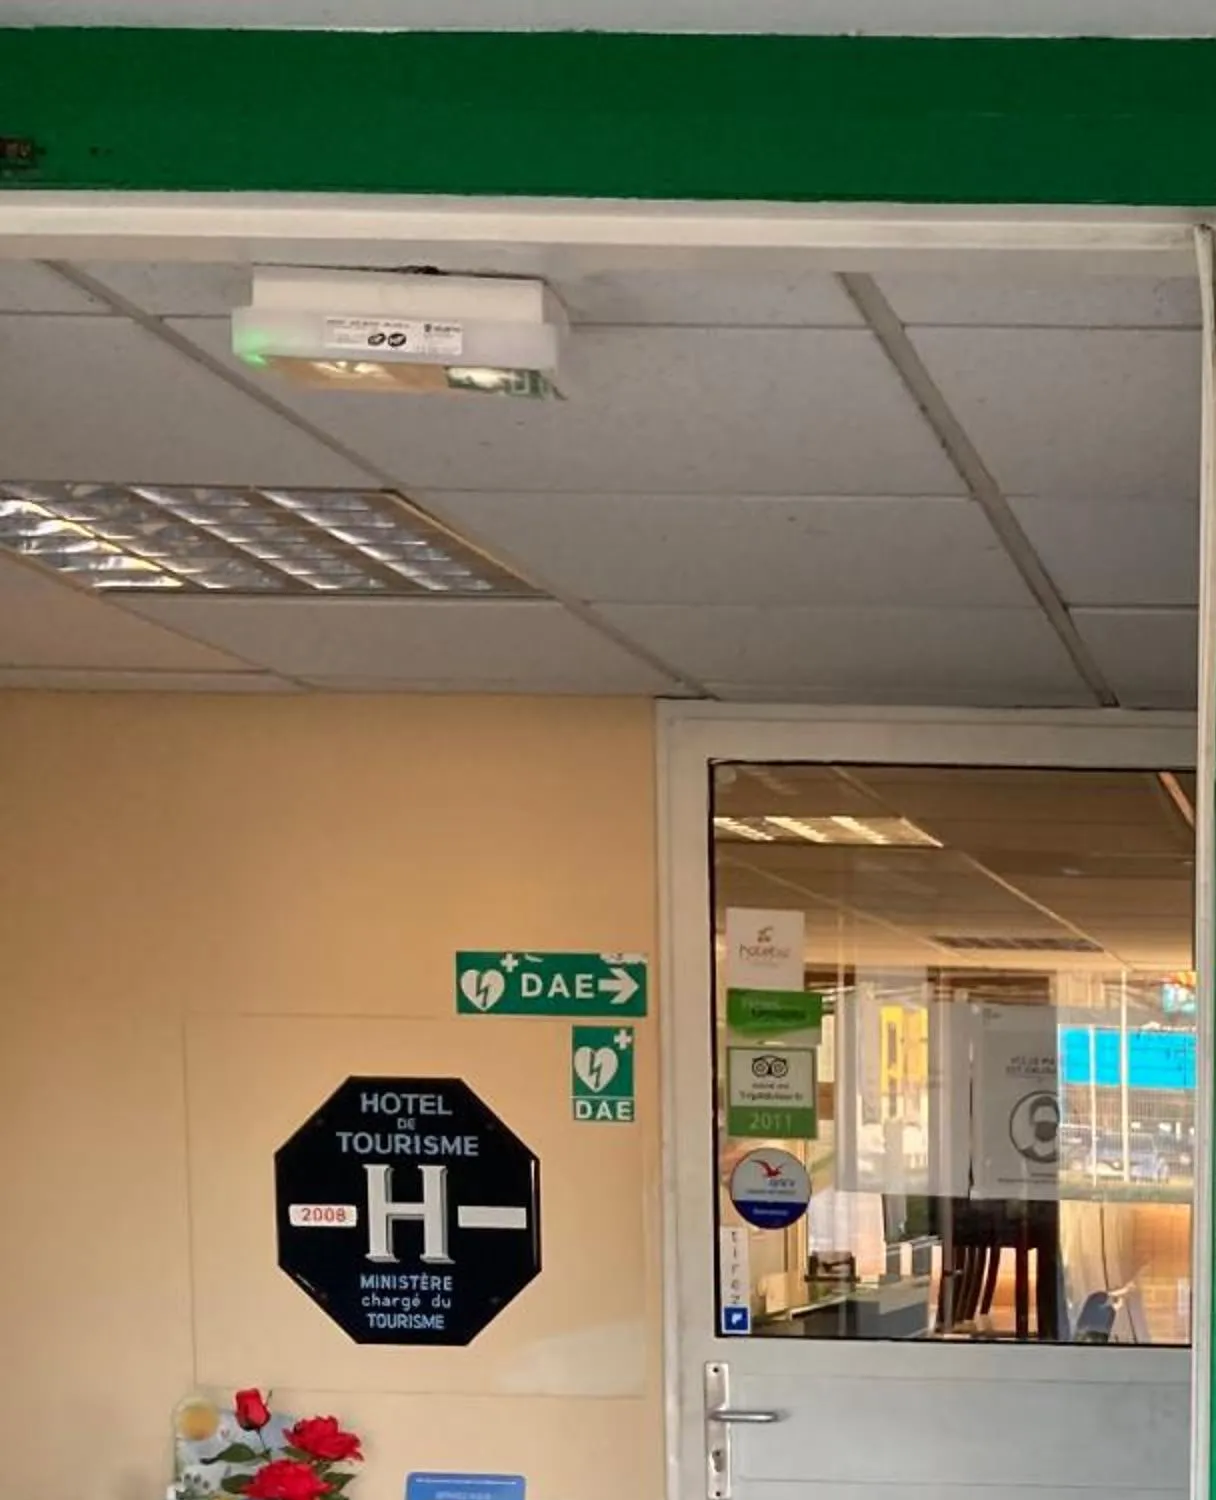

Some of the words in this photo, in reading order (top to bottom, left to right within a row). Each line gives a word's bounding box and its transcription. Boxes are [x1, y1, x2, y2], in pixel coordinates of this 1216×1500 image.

[520, 972, 596, 999] DAE
[360, 1091, 454, 1117] HOTEL
[575, 1099, 632, 1120] DAE
[397, 1117, 417, 1130] DE
[750, 1111, 792, 1133] 2011
[335, 1130, 480, 1158] TOURISME
[300, 1206, 347, 1223] 2008
[362, 1163, 456, 1264] H
[360, 1271, 454, 1292] MINISTÈRE
[361, 1293, 421, 1311] chargé
[431, 1293, 452, 1309] du
[367, 1312, 446, 1330] TOURISME
